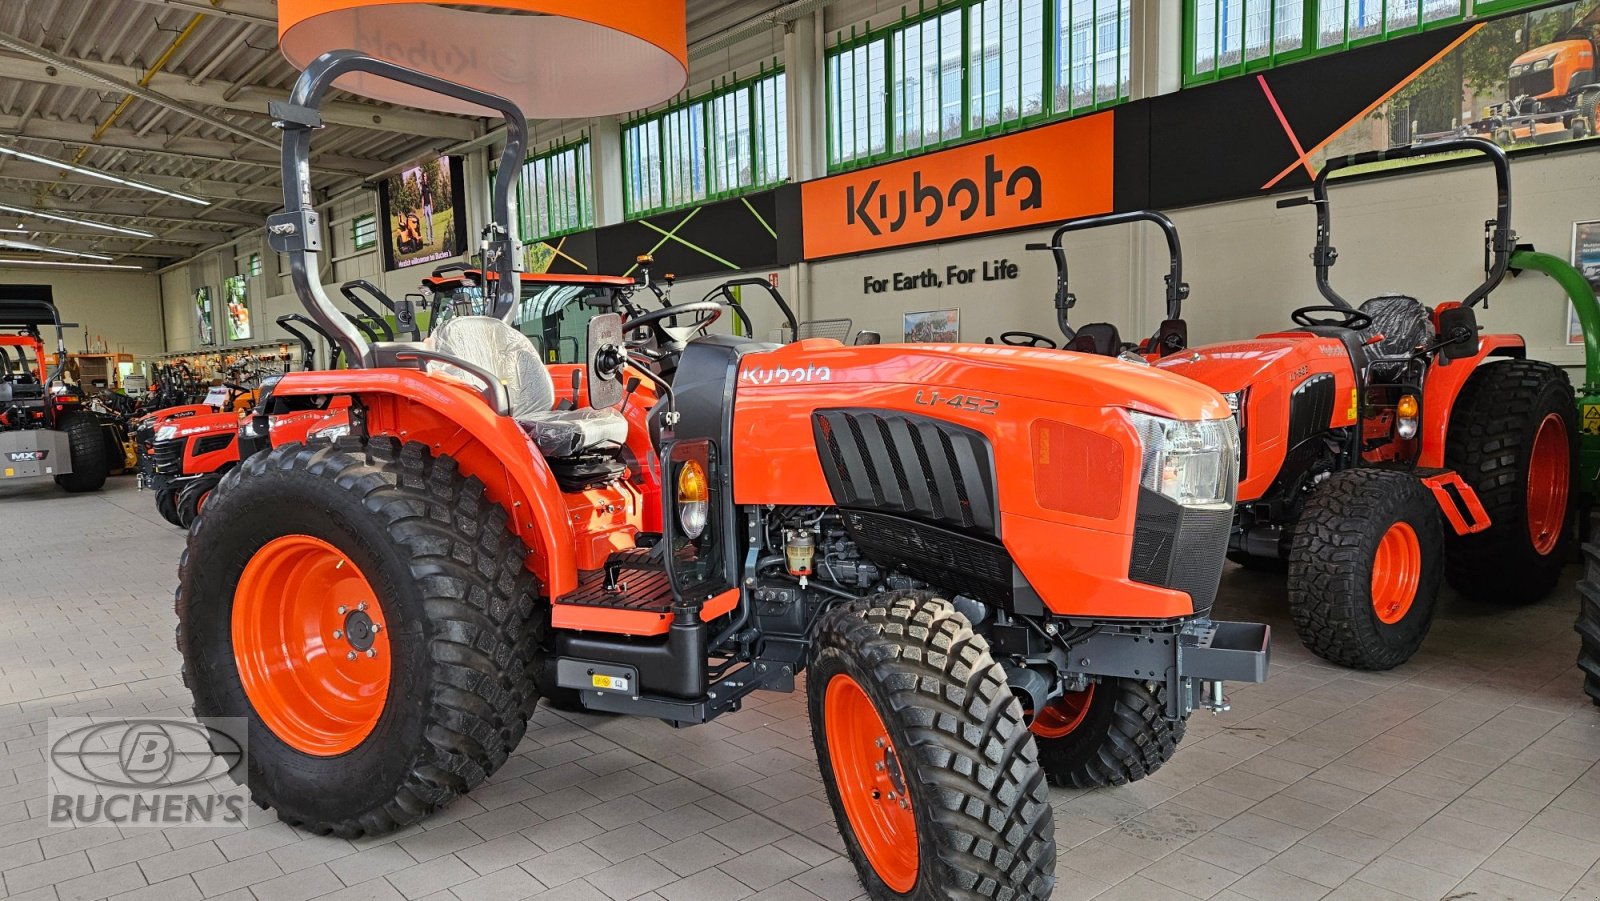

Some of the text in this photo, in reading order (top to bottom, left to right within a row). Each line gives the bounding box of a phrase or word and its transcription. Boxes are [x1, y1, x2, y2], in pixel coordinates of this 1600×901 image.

[846, 154, 1042, 235] Kubota
[863, 258, 1018, 294] For Earth, For Life
[742, 361, 830, 384] Kubota
[914, 390, 1000, 416] L1-452
